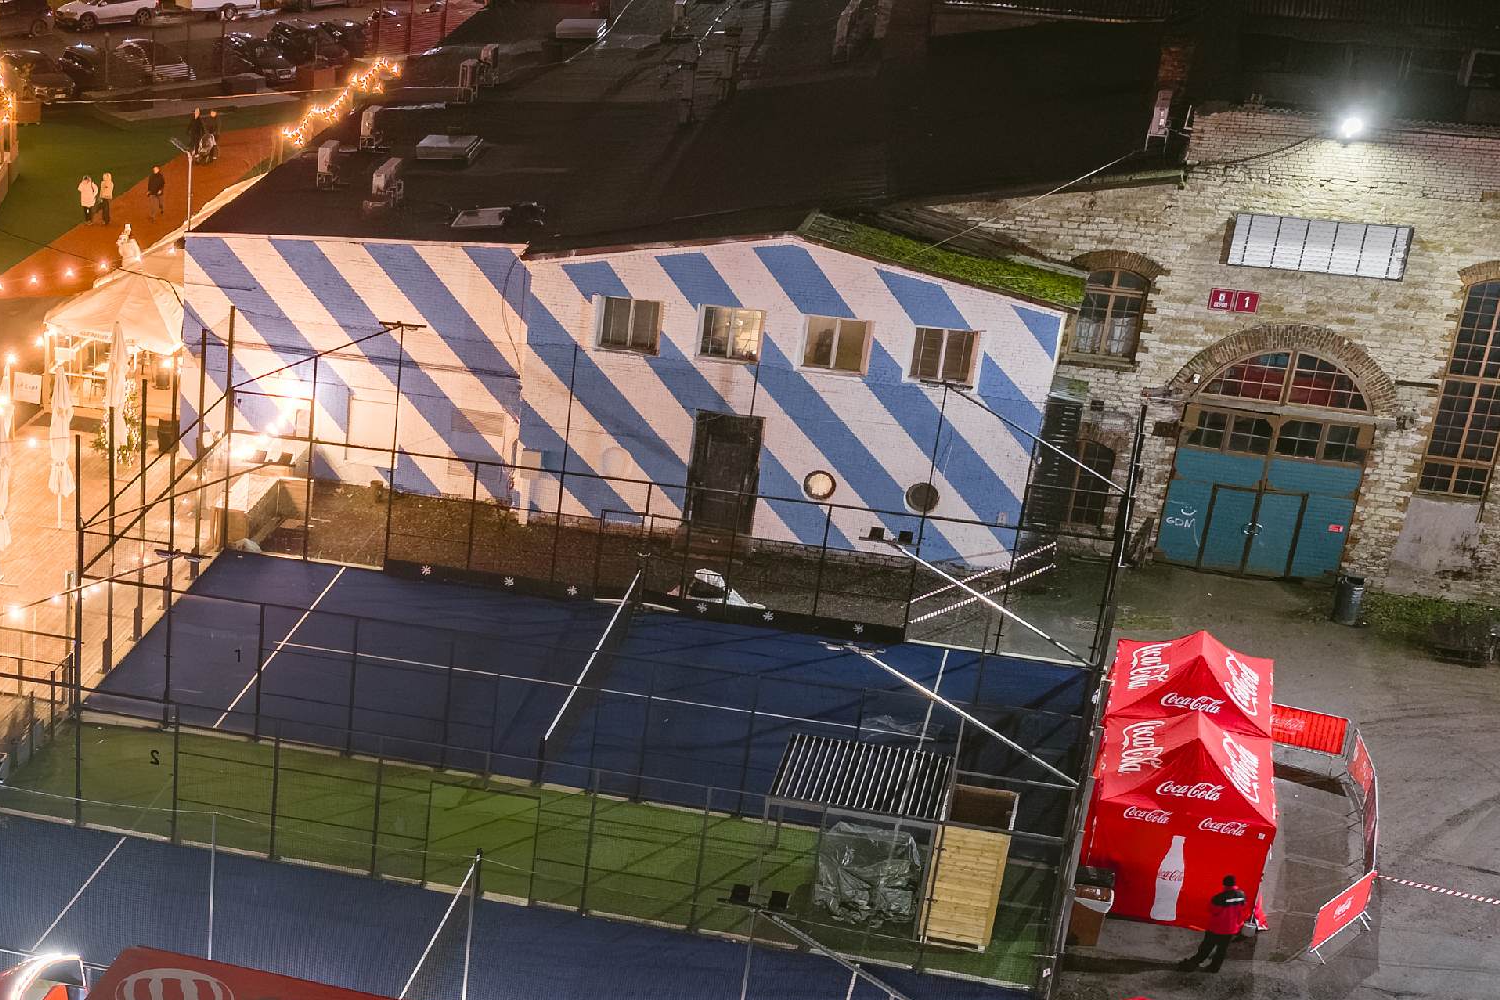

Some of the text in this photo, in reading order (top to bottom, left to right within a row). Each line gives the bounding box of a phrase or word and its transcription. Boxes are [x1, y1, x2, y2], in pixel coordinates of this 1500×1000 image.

[1244, 296, 1250, 308] 1
[1160, 692, 1226, 714] Coca-Cola
[1117, 720, 1166, 775] Coca-Cola
[1155, 780, 1226, 802] Coca-Cola
[1123, 805, 1173, 825] Coca-Cola
[1198, 817, 1249, 838] Coca-Cola
